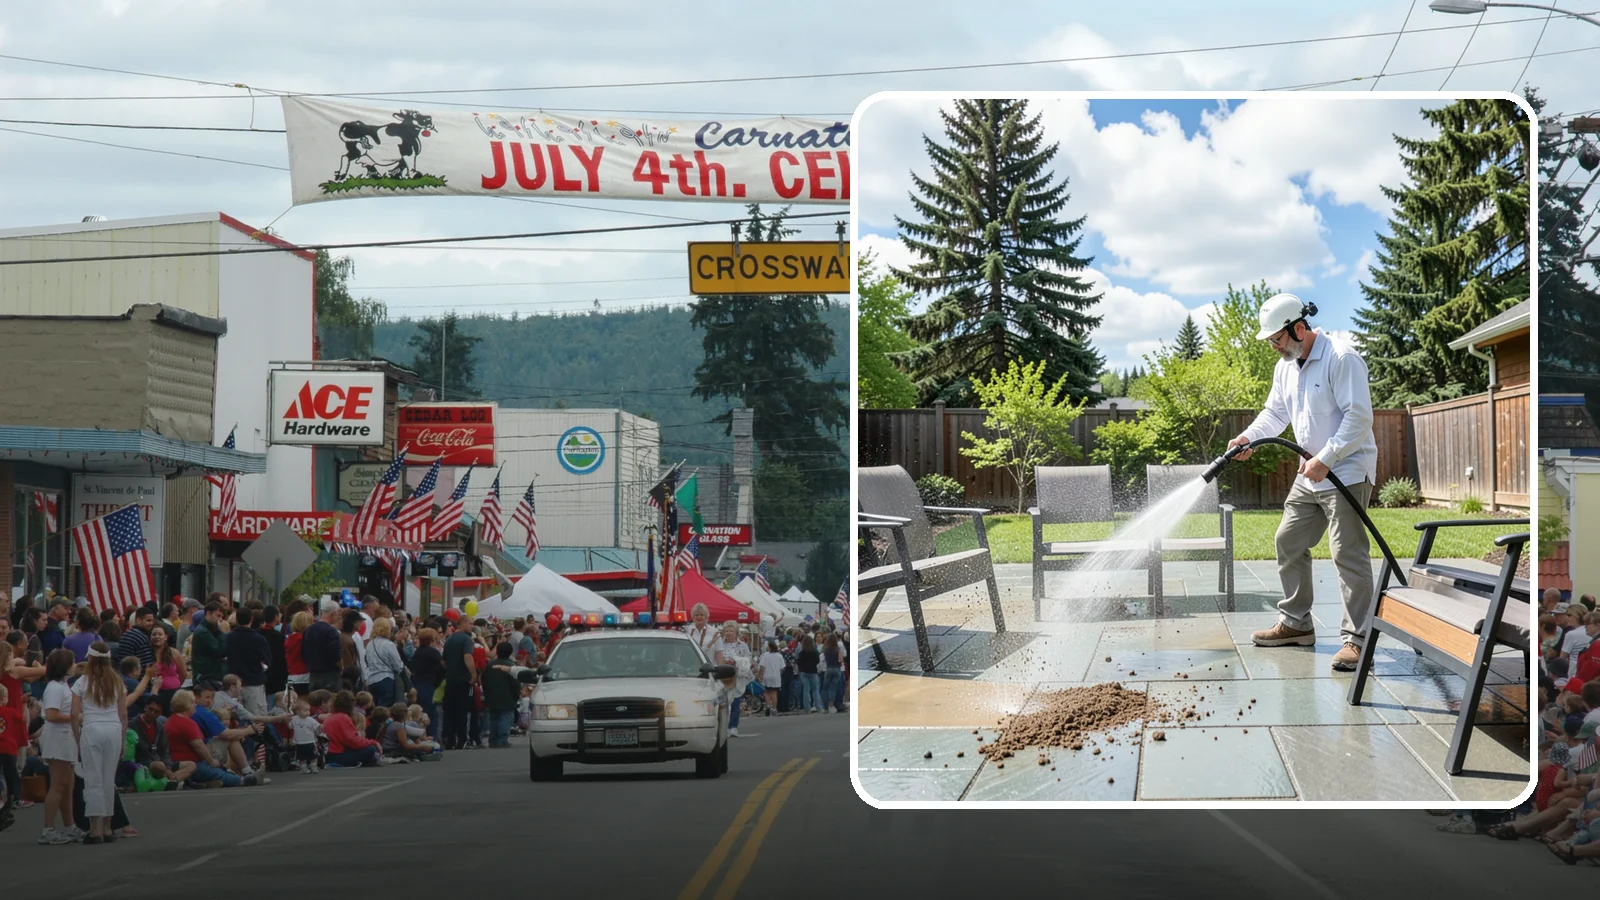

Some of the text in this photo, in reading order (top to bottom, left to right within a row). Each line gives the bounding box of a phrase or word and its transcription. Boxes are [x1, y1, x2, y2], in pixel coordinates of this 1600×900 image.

[695, 121, 850, 150] Carnat
[481, 141, 605, 192] JULY
[632, 150, 747, 198] 4th.
[697, 254, 850, 280] CROSSWA
[282, 380, 374, 420] ACE
[405, 409, 485, 422] CEDAR LOG
[284, 421, 371, 437] Hardware
[416, 428, 477, 447] Coca-Cola
[353, 467, 385, 480] Simpl
[83, 484, 155, 495] St. Vincent de Paul
[688, 526, 741, 535] CRNATION
[699, 535, 730, 543] GLASS
